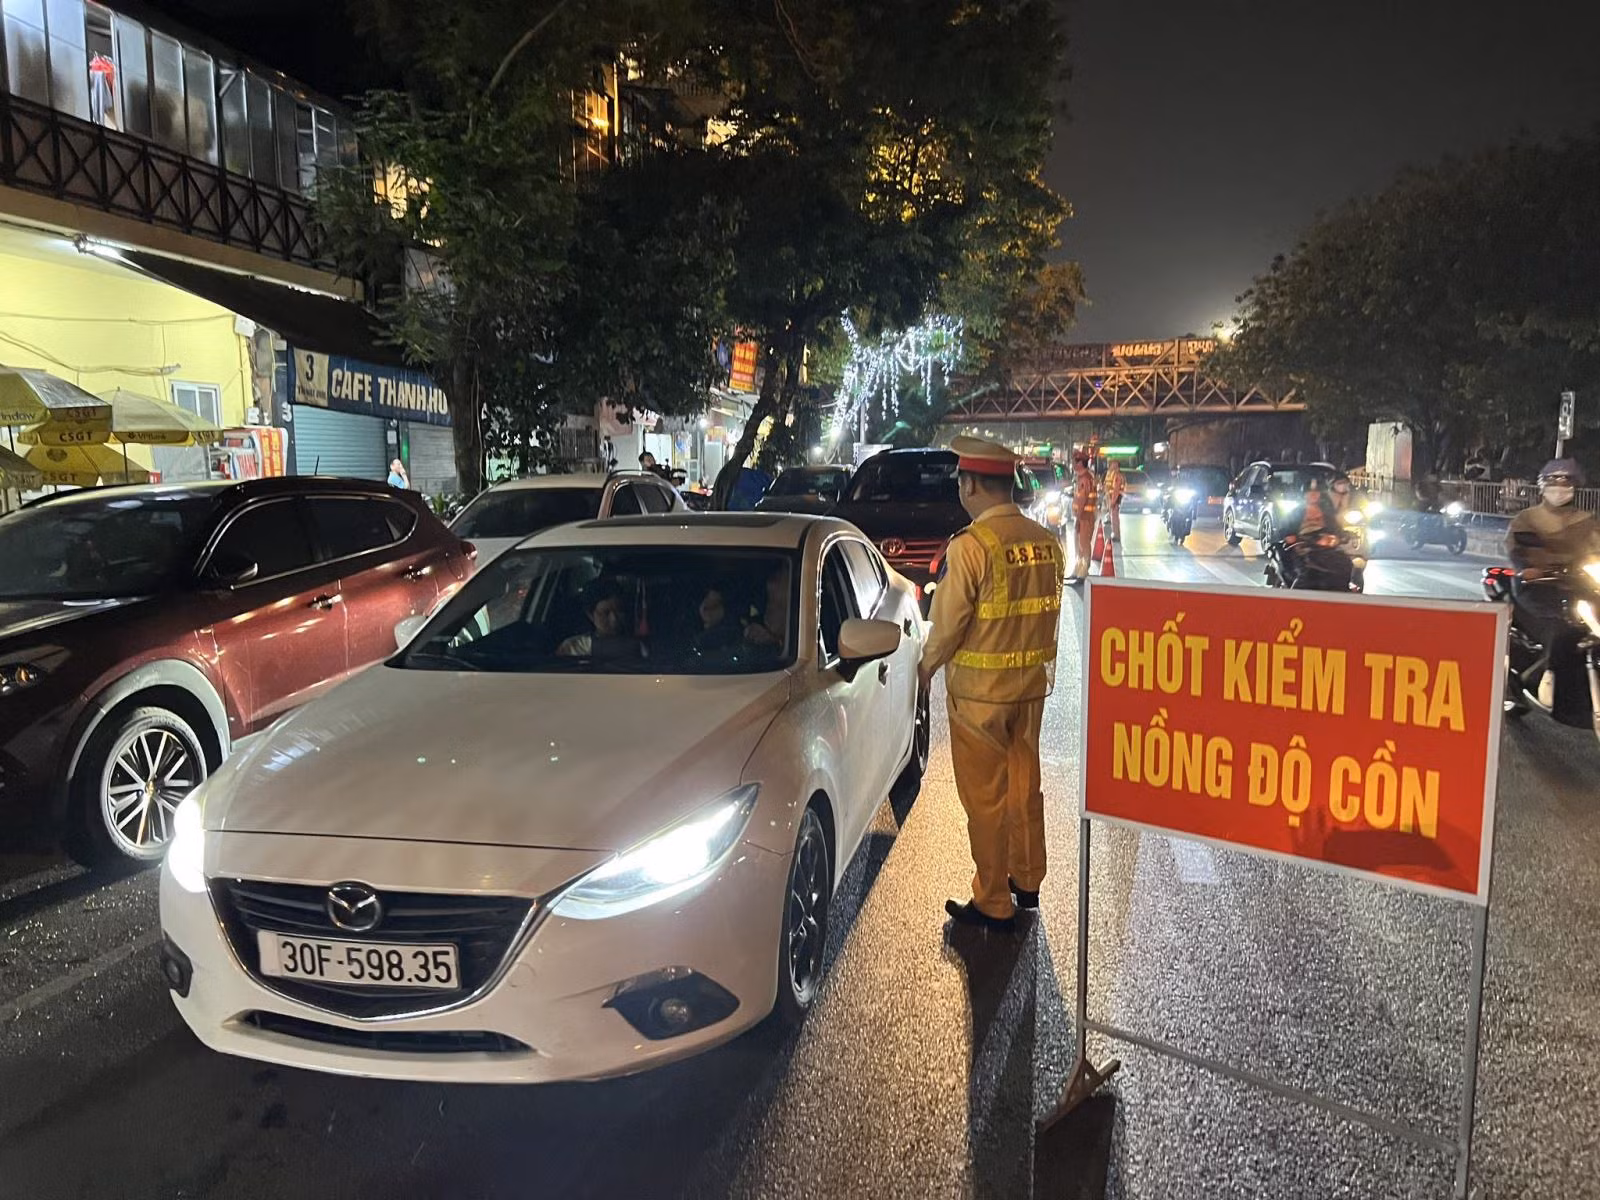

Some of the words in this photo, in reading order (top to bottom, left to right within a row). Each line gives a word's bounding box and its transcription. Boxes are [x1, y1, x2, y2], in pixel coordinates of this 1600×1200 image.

[305, 353, 315, 382] 3
[331, 368, 373, 403] CAFE
[377, 376, 427, 412] THANH
[59, 431, 93, 442] CSGT
[1100, 611, 1209, 697] CHỐT
[1223, 617, 1347, 716] KIỂM
[1364, 652, 1466, 732] TRA
[1112, 707, 1234, 799] NỒNG
[1247, 735, 1312, 828] ĐỘ
[1329, 740, 1440, 839] CỒN
[281, 940, 452, 984] 30F-598.35
